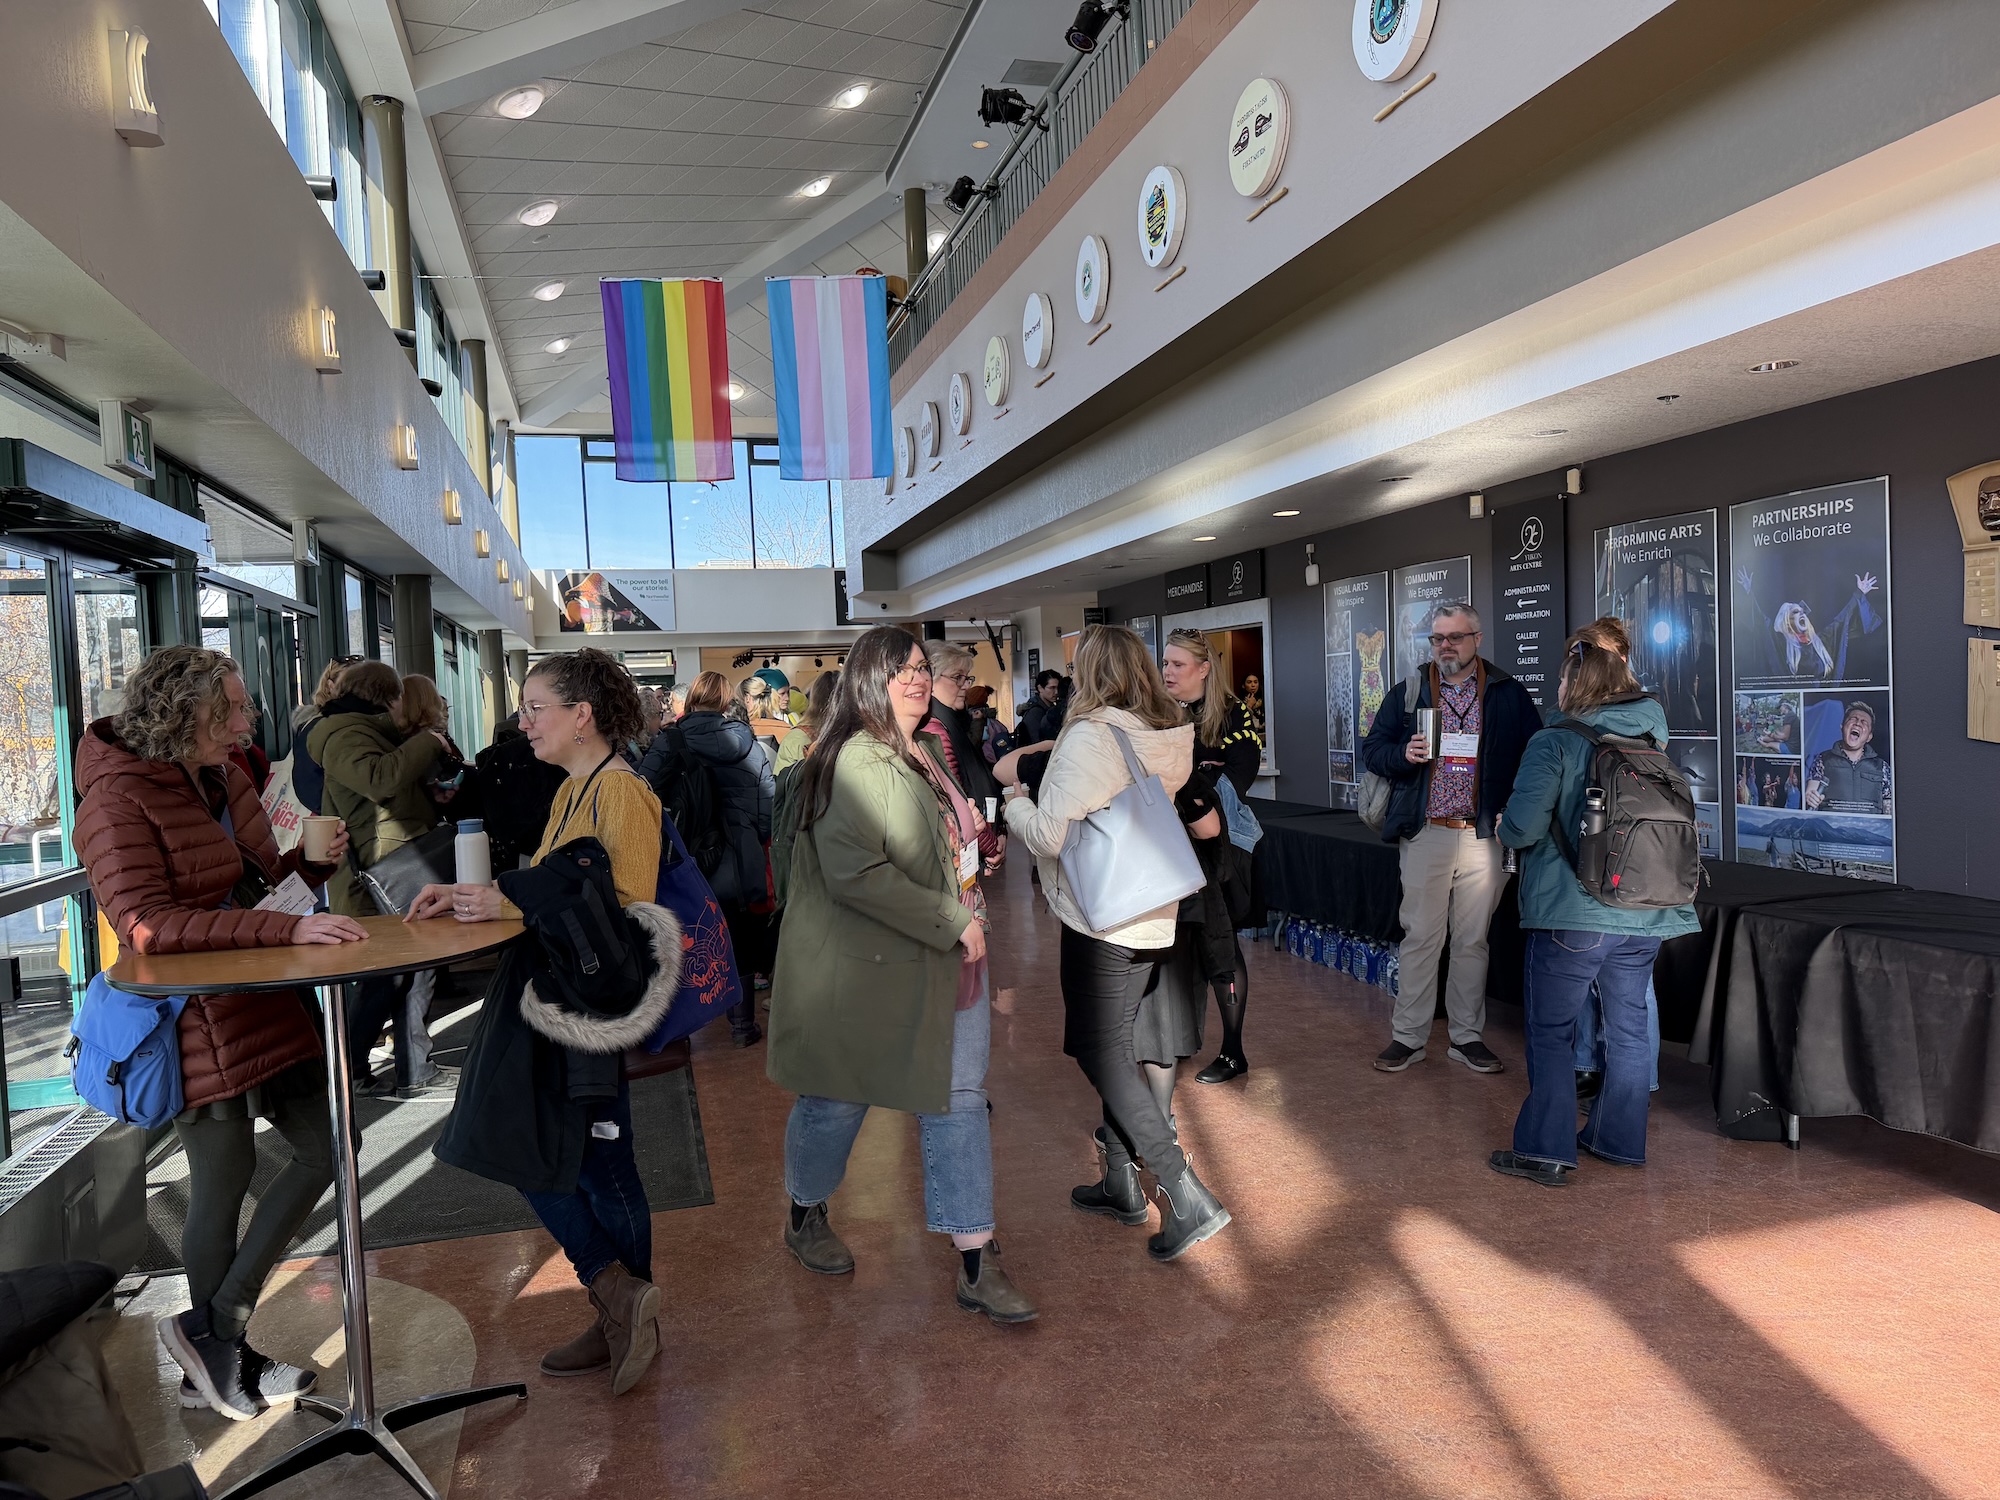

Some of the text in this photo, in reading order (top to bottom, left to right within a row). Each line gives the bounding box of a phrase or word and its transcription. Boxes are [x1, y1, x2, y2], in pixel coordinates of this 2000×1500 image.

[1752, 498, 1854, 528] PARTNERSHIPS
[1604, 523, 1703, 550] PERFORMING ARTS
[1753, 521, 1852, 547] We Collaborate
[1525, 552, 1542, 560] YUKON
[1622, 546, 1672, 564] We Enrich
[1509, 561, 1542, 572] ARTS CENTRE
[1405, 570, 1448, 585] COMMUNITY
[1168, 581, 1203, 598] MERCHANDISE
[1334, 582, 1368, 595] VISUAL ARTS
[1408, 586, 1442, 598] We Engage
[1504, 584, 1550, 596] ADMINISTRATION
[1345, 596, 1364, 606] Inspire
[1505, 610, 1550, 621] ADMINISTRATION
[1516, 632, 1539, 640] GALLERY
[1517, 657, 1539, 665] GALERIE
